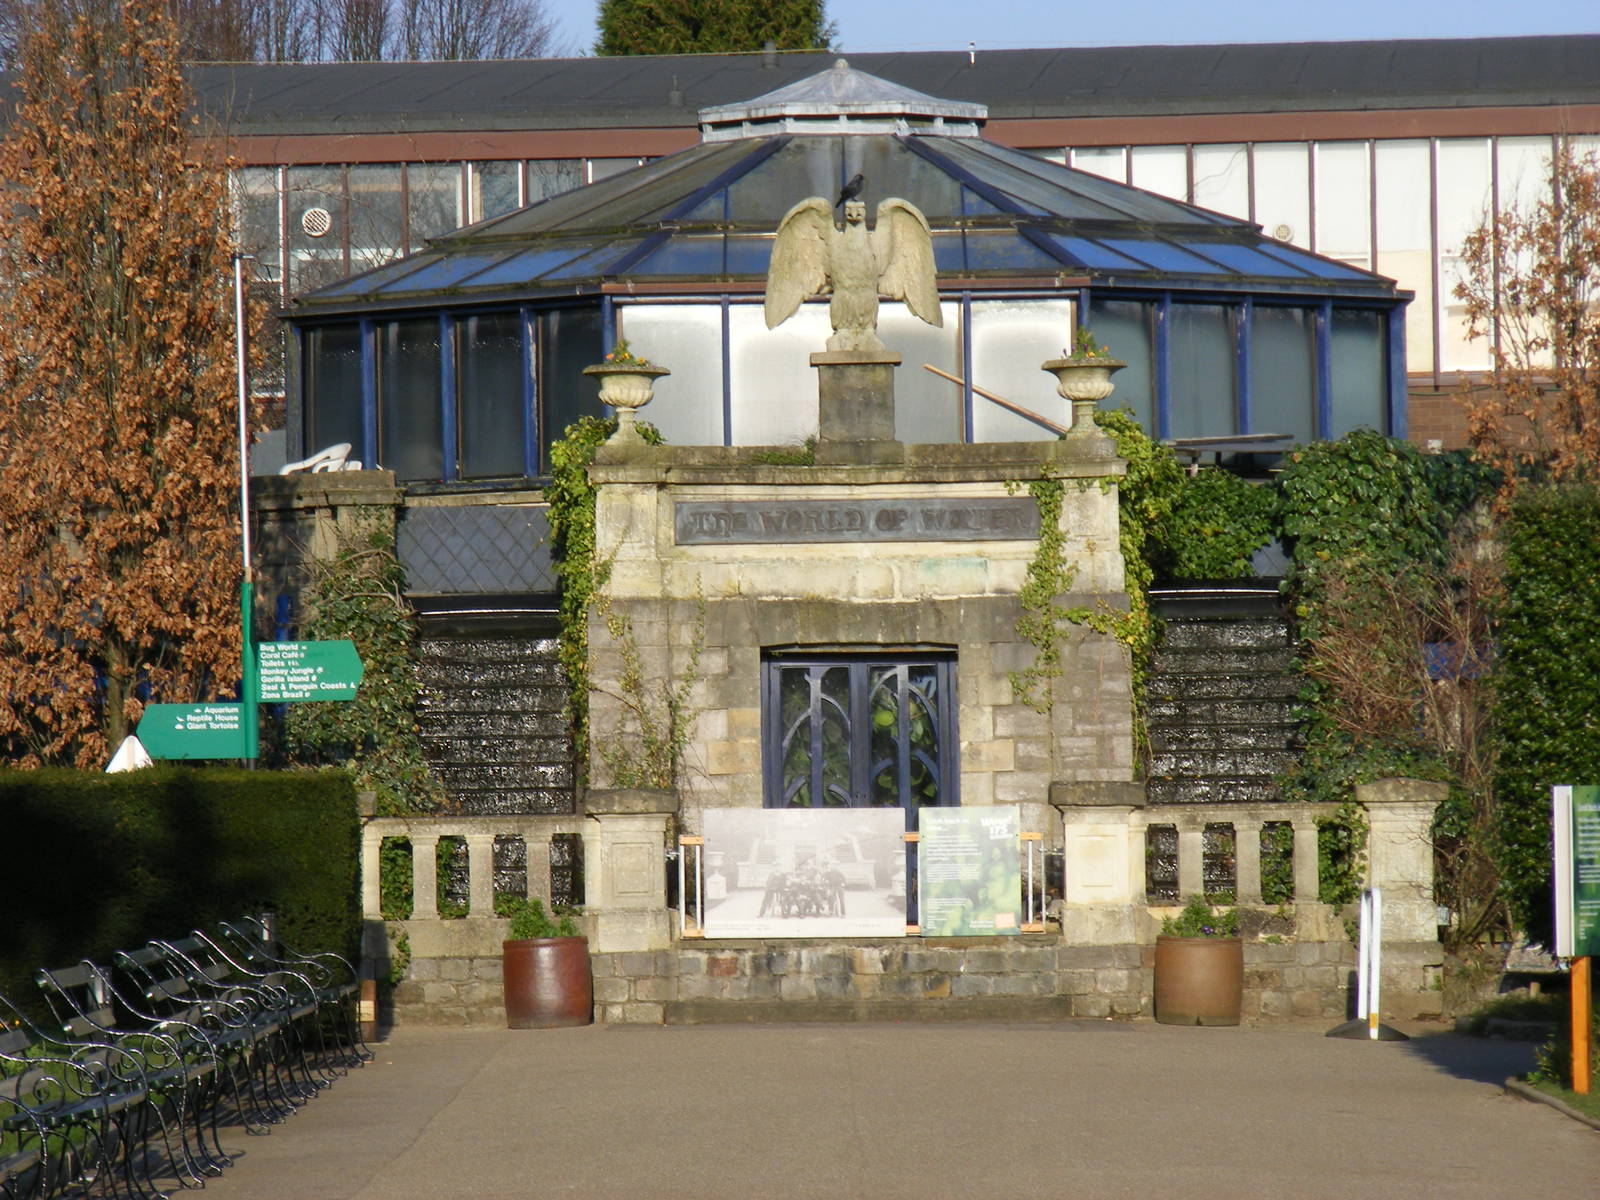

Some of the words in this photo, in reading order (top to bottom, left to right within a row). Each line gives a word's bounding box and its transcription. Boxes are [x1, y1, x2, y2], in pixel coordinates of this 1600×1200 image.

[689, 511, 748, 537] THE
[758, 508, 865, 533] WORLD
[875, 508, 908, 532] OF
[919, 507, 1031, 531] WATER
[260, 644, 275, 652] Bug
[277, 643, 299, 651] World
[261, 668, 288, 676] Monkey
[290, 667, 314, 675] Jungle
[289, 683, 318, 691] Penguin
[320, 682, 347, 690] Coasts
[204, 706, 239, 714] Aquarium
[187, 714, 212, 722] Reptile
